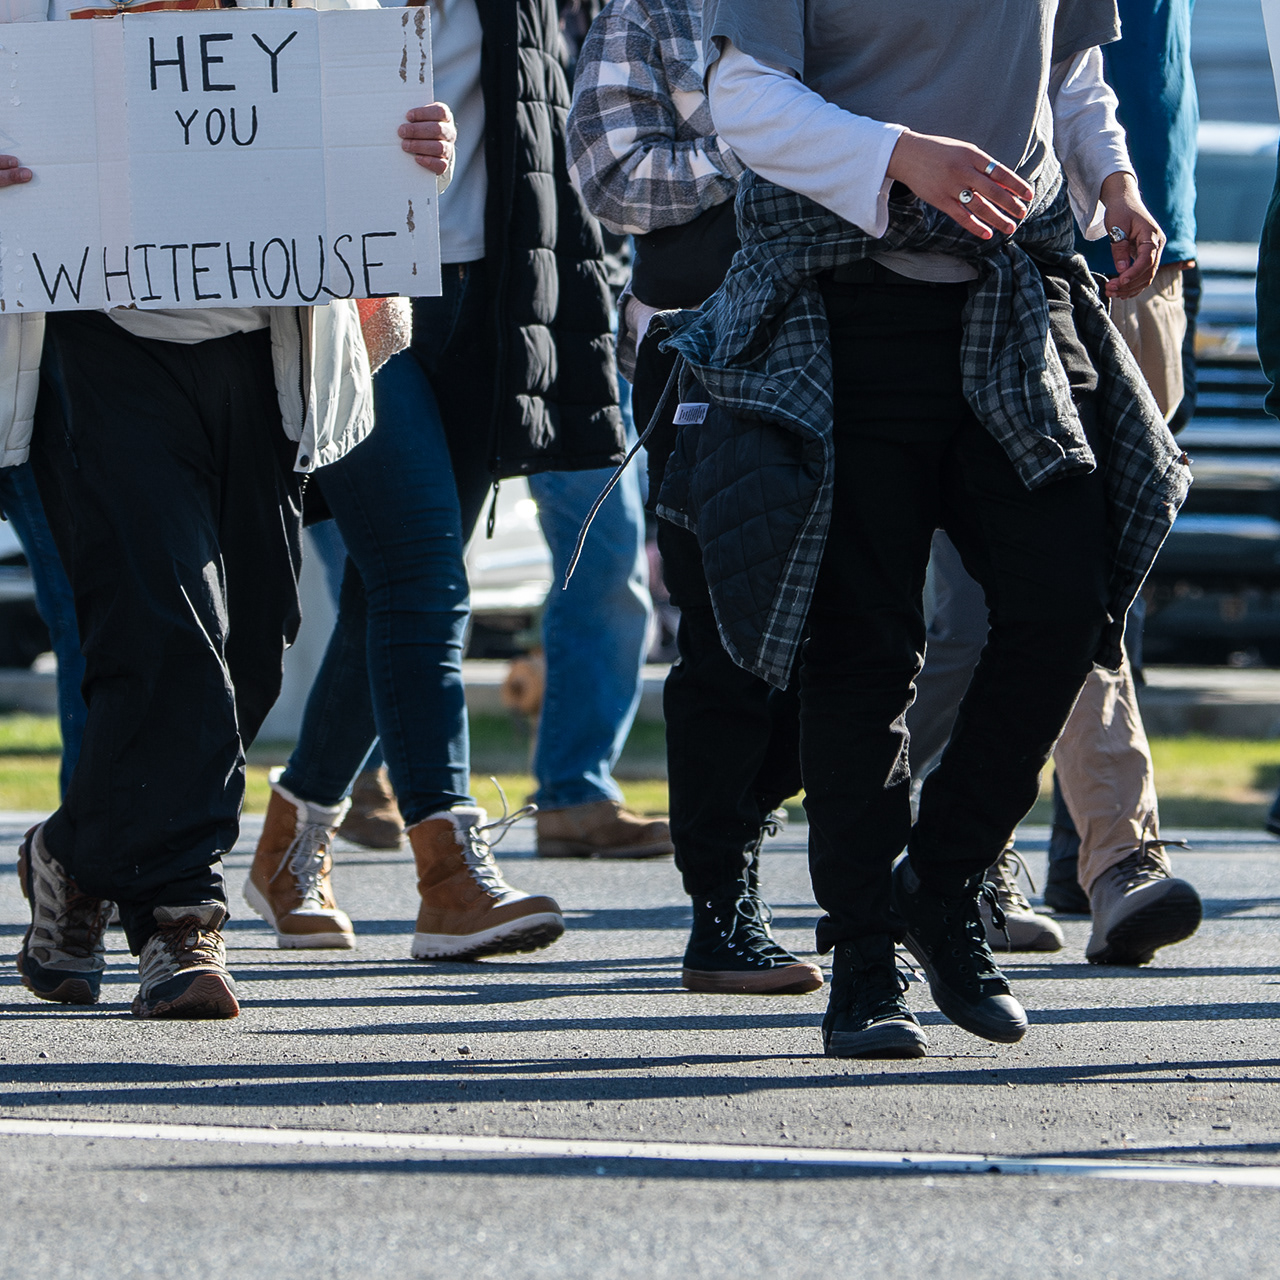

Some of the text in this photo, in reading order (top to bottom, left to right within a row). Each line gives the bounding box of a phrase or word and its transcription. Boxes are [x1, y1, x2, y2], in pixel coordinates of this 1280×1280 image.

[148, 30, 298, 94] HEY
[175, 105, 258, 146] YOU
[32, 231, 401, 305] WHITEHOUSE
